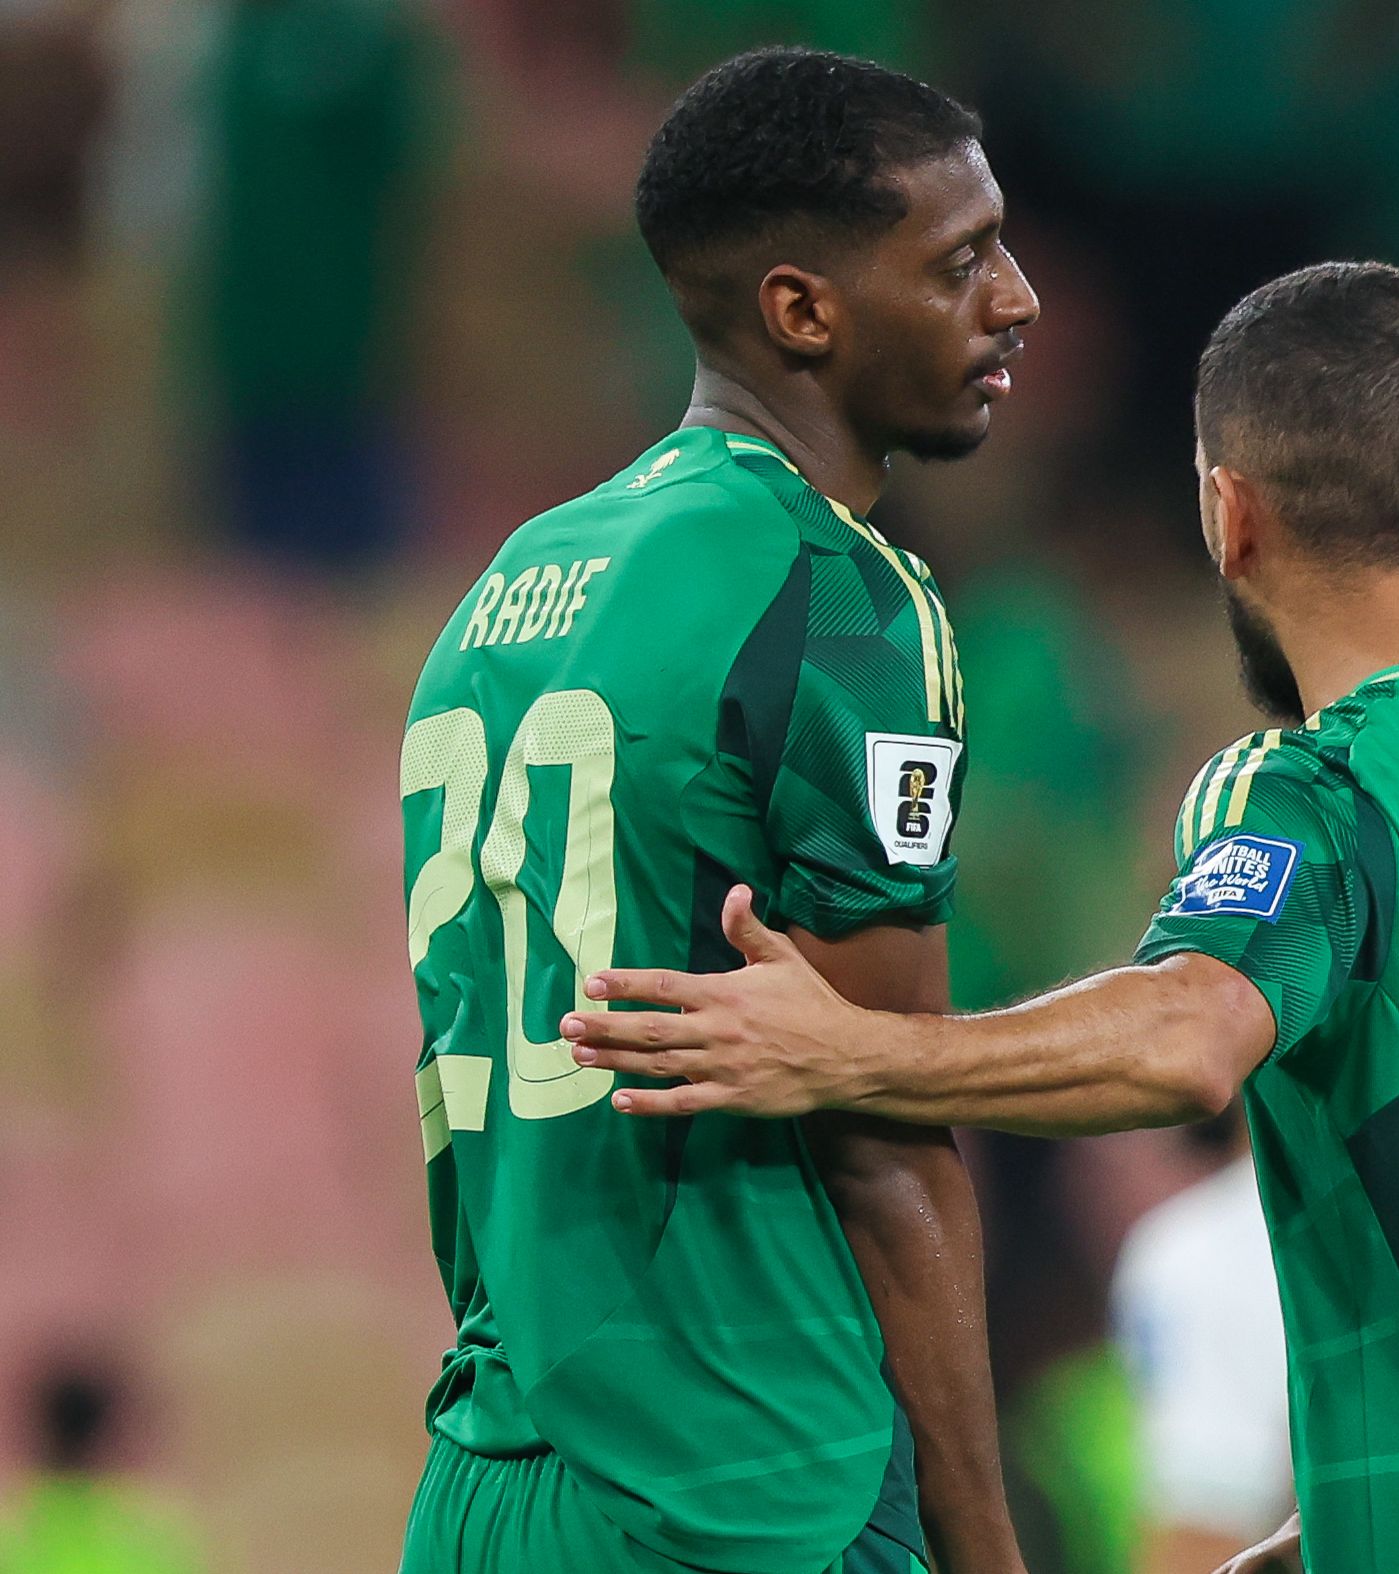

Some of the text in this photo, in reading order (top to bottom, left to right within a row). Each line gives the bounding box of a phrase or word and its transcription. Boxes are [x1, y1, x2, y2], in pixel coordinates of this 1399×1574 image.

[459, 556, 612, 652] RADIF
[905, 822, 922, 832] FIFA
[894, 840, 929, 850] QUALIFIERS
[1212, 856, 1269, 880] NITES
[1212, 889, 1237, 899] FIFA
[400, 689, 618, 1151] 20
